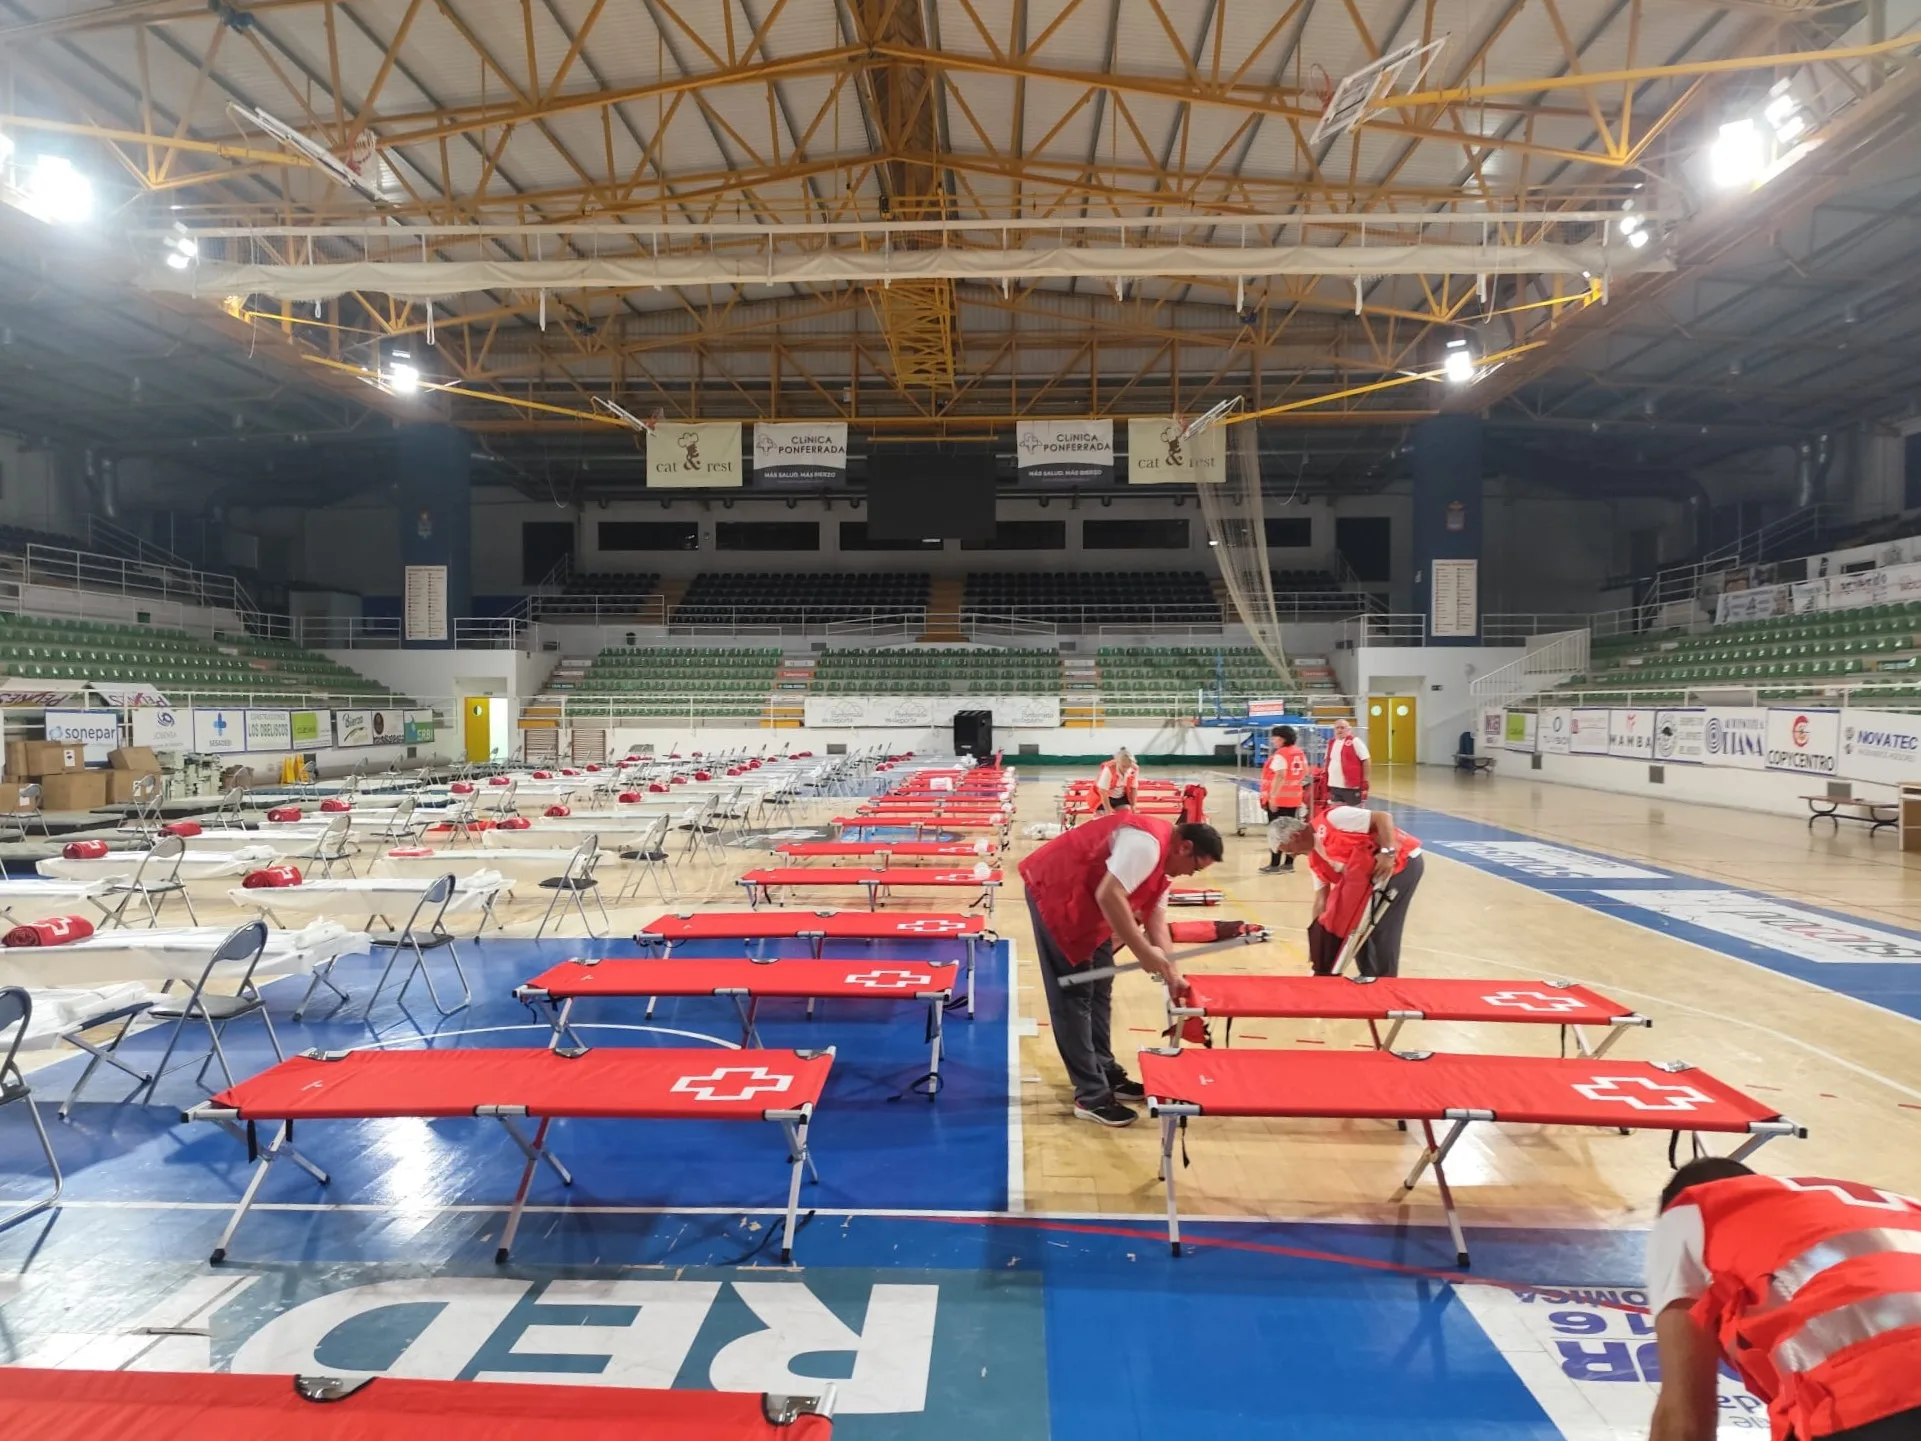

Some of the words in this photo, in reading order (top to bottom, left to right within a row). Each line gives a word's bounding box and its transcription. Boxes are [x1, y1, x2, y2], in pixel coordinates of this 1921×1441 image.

[778, 445, 846, 454] PONFERRADA
[1043, 442, 1110, 452] PONFERRADA
[656, 461, 678, 473] cat
[707, 461, 733, 473] rest
[1138, 458, 1160, 469] cat
[65, 727, 116, 740] sonepar
[1609, 735, 1651, 748] MAMBA
[1857, 730, 1918, 750] NOVATEC
[1768, 750, 1834, 771] COPYCENTRO
